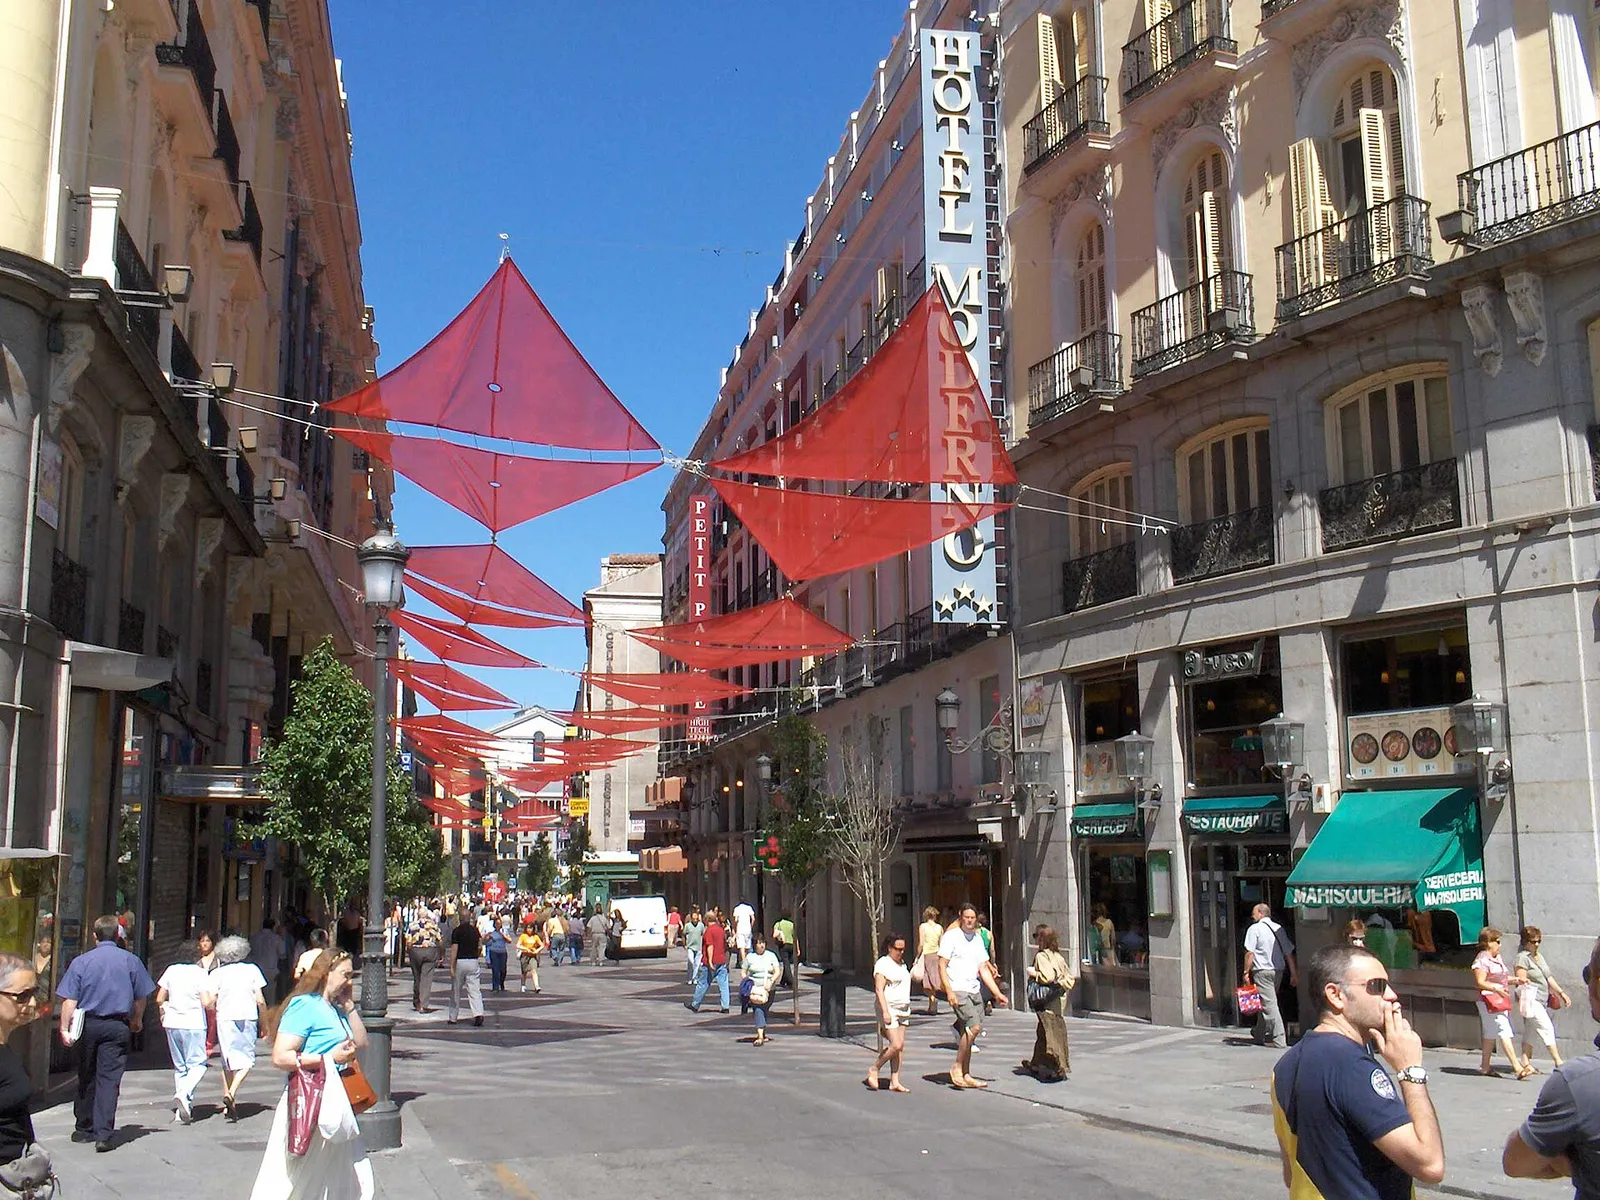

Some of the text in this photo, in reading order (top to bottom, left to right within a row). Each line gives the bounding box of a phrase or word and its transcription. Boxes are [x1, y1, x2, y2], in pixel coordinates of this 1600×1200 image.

[931, 32, 985, 569] HOTEL MODERNO
[694, 500, 707, 587] PETIT
[1293, 887, 1413, 904] MARISQUERIA
